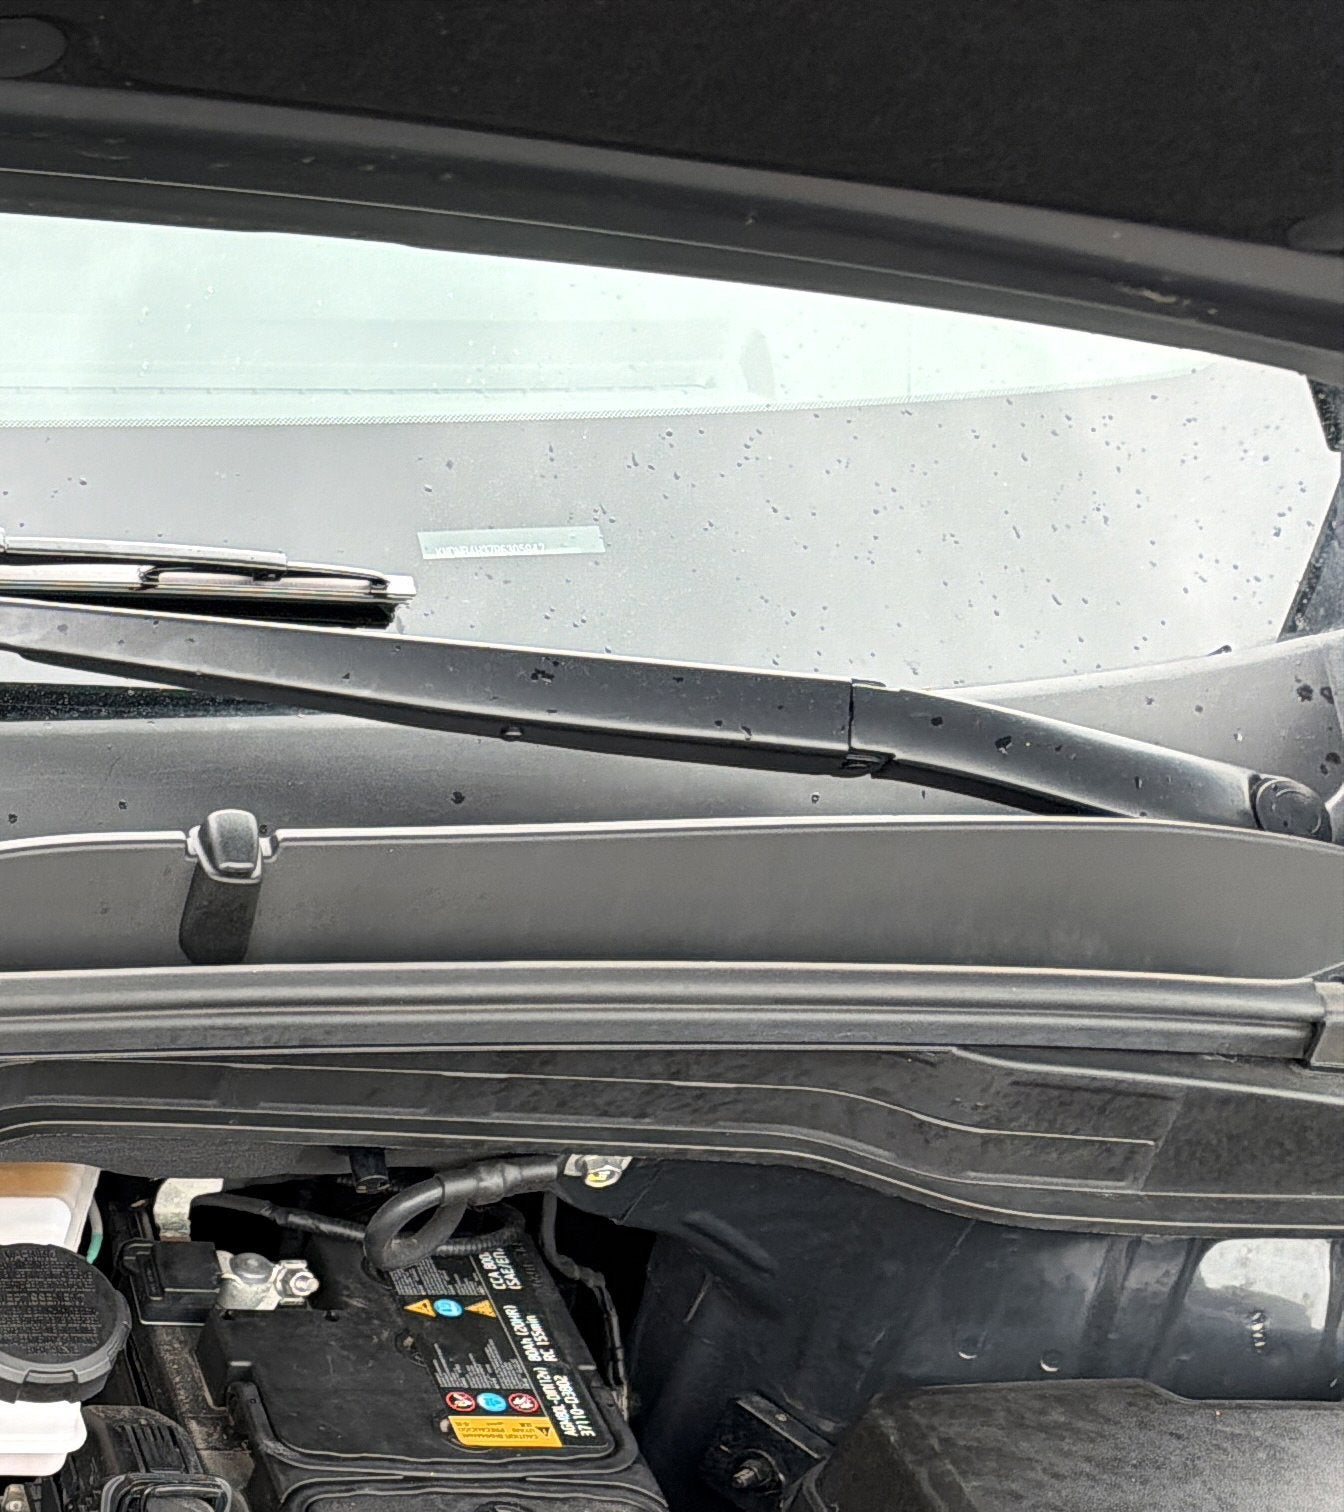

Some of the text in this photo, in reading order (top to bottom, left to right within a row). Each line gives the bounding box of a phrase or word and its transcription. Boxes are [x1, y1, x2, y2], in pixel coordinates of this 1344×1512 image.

[488, 1271, 508, 1290] CCA
[503, 1304, 530, 1336] (20HR)
[520, 1338, 542, 1361] 80Ah
[540, 1348, 558, 1361] RC
